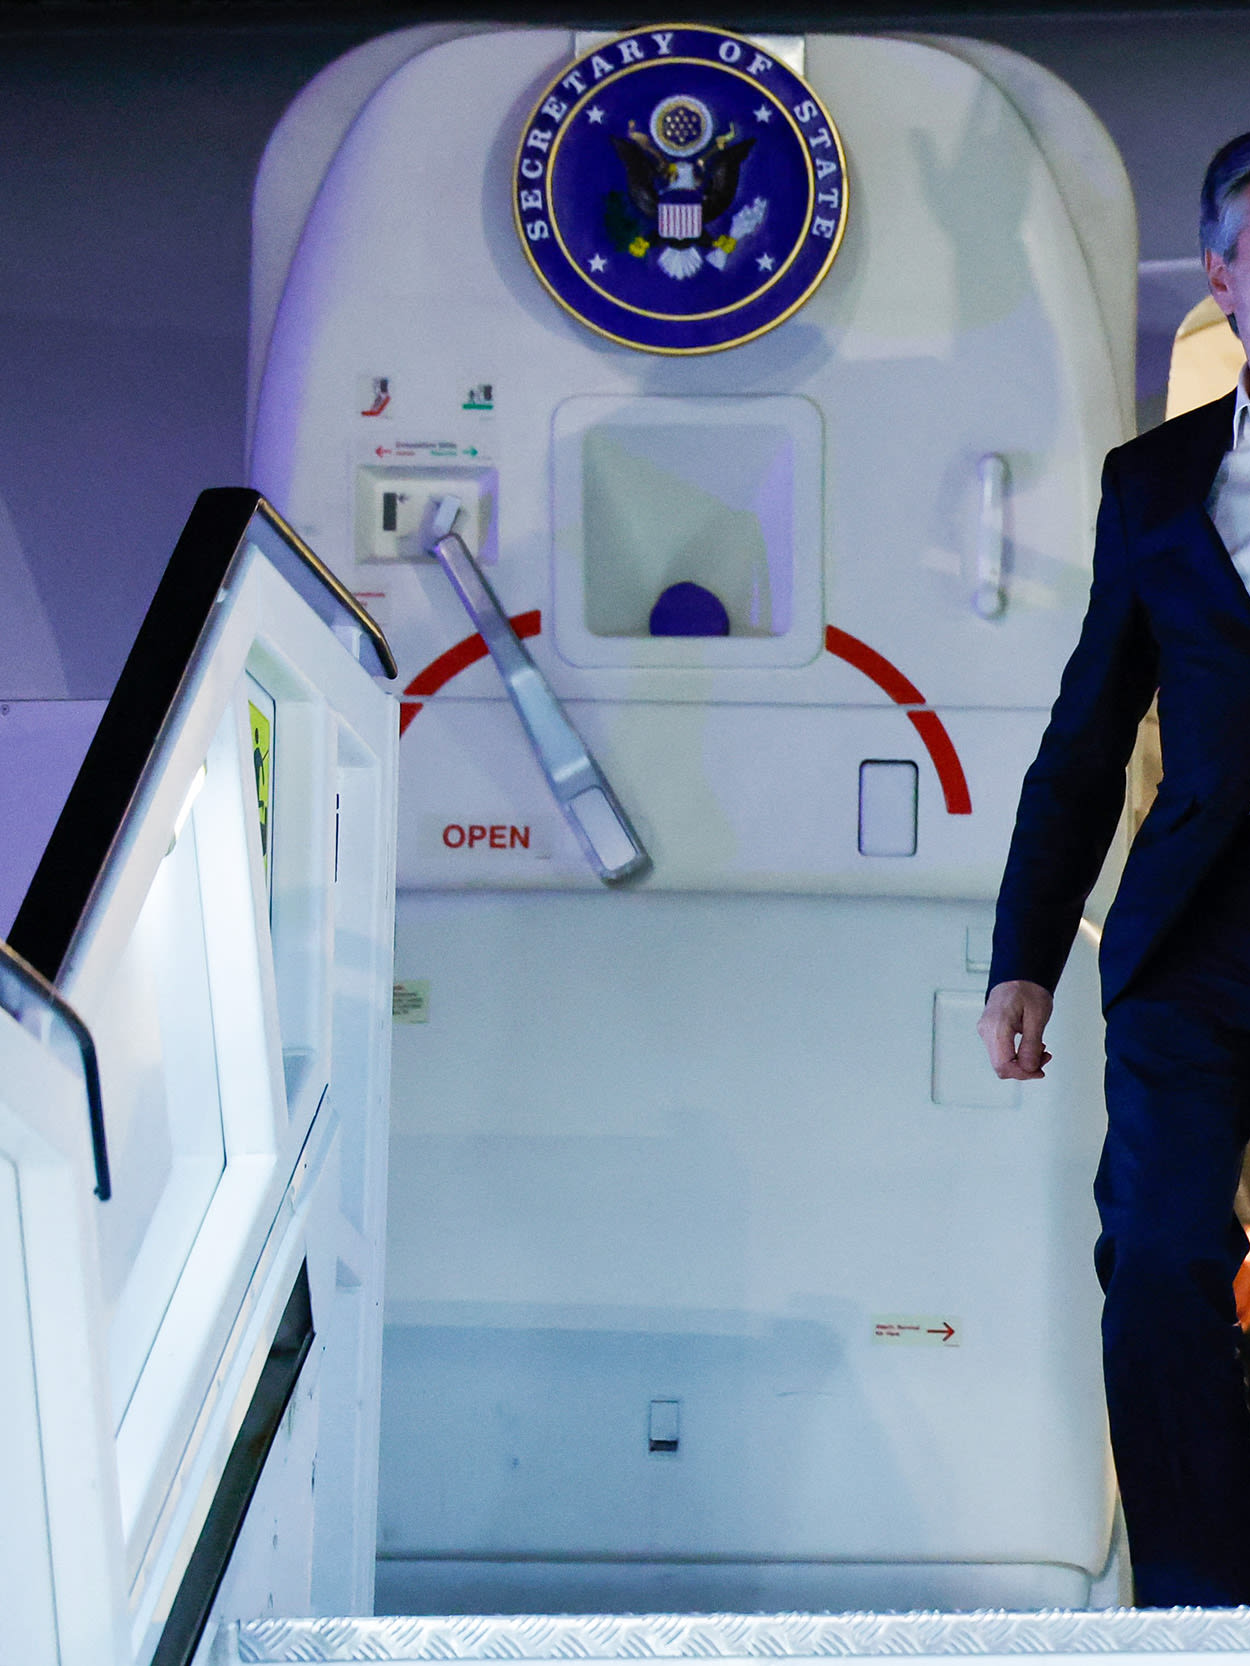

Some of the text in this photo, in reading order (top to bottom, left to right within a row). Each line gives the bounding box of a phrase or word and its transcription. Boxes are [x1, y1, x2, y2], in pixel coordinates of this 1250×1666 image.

[521, 32, 839, 240] SECRETARY OF STATE
[442, 824, 530, 849] OPEN
